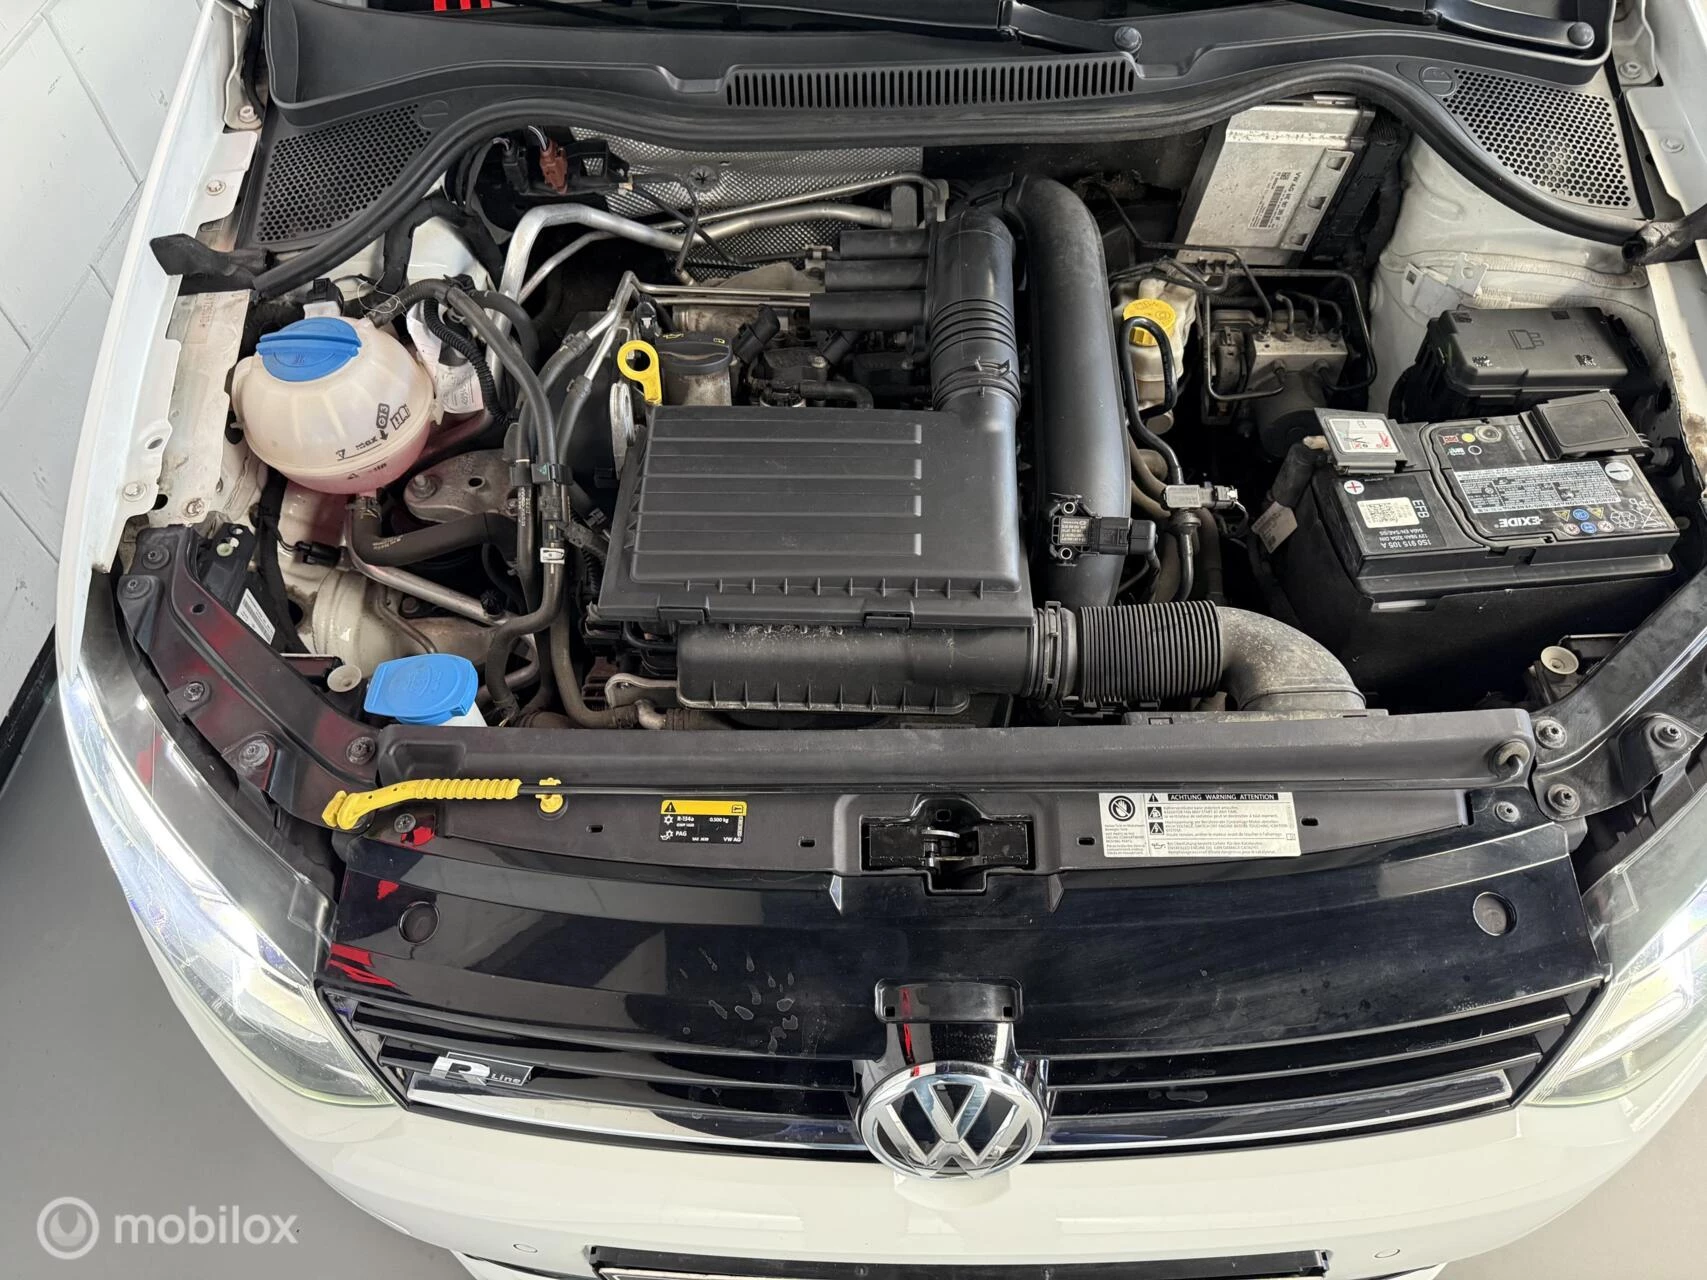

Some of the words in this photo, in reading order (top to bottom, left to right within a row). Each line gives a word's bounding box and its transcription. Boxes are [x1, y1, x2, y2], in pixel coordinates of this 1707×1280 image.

[378, 405, 389, 427] G13
[1412, 500, 1430, 518] EFB
[1498, 516, 1543, 528] EXIDE
[1402, 540, 1417, 548] 915
